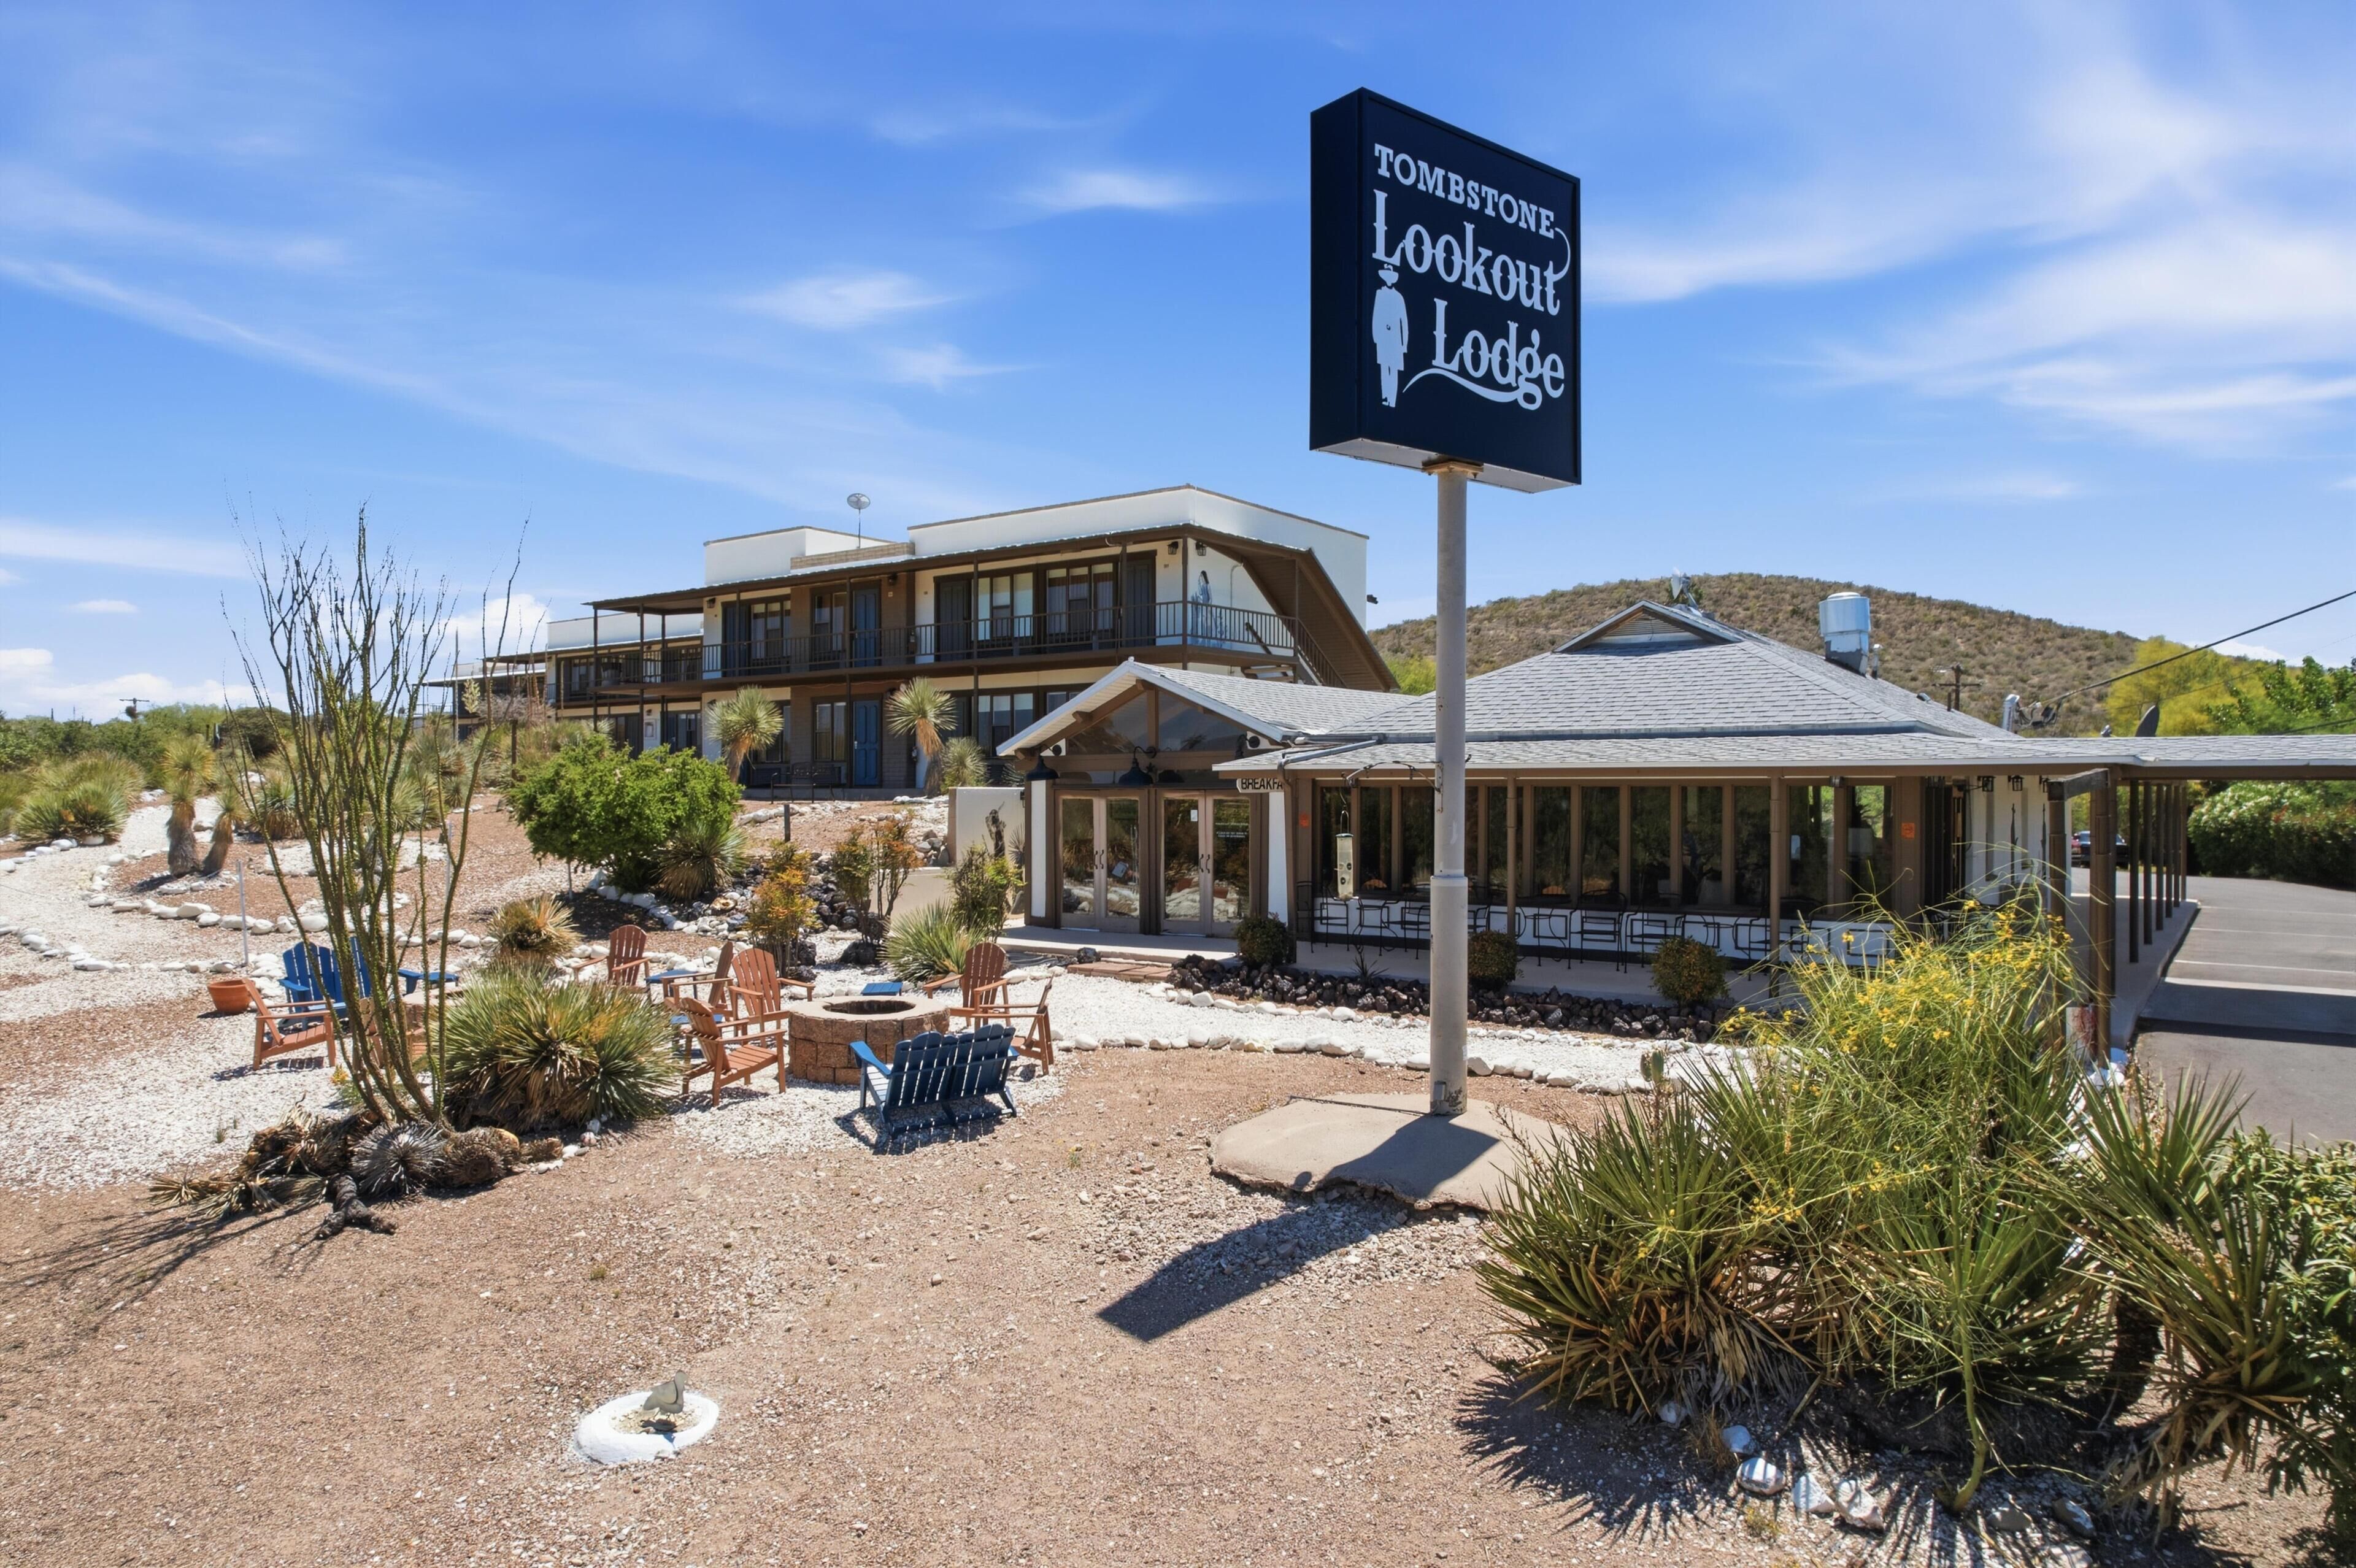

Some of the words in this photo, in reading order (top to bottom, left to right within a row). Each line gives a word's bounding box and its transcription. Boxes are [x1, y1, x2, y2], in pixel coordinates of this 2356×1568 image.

[1374, 143, 1554, 239] TOMBSTONE
[1372, 189, 1570, 316] Lookout
[1432, 298, 1565, 410] Lodge
[1241, 778, 1283, 790] BREAKFA
